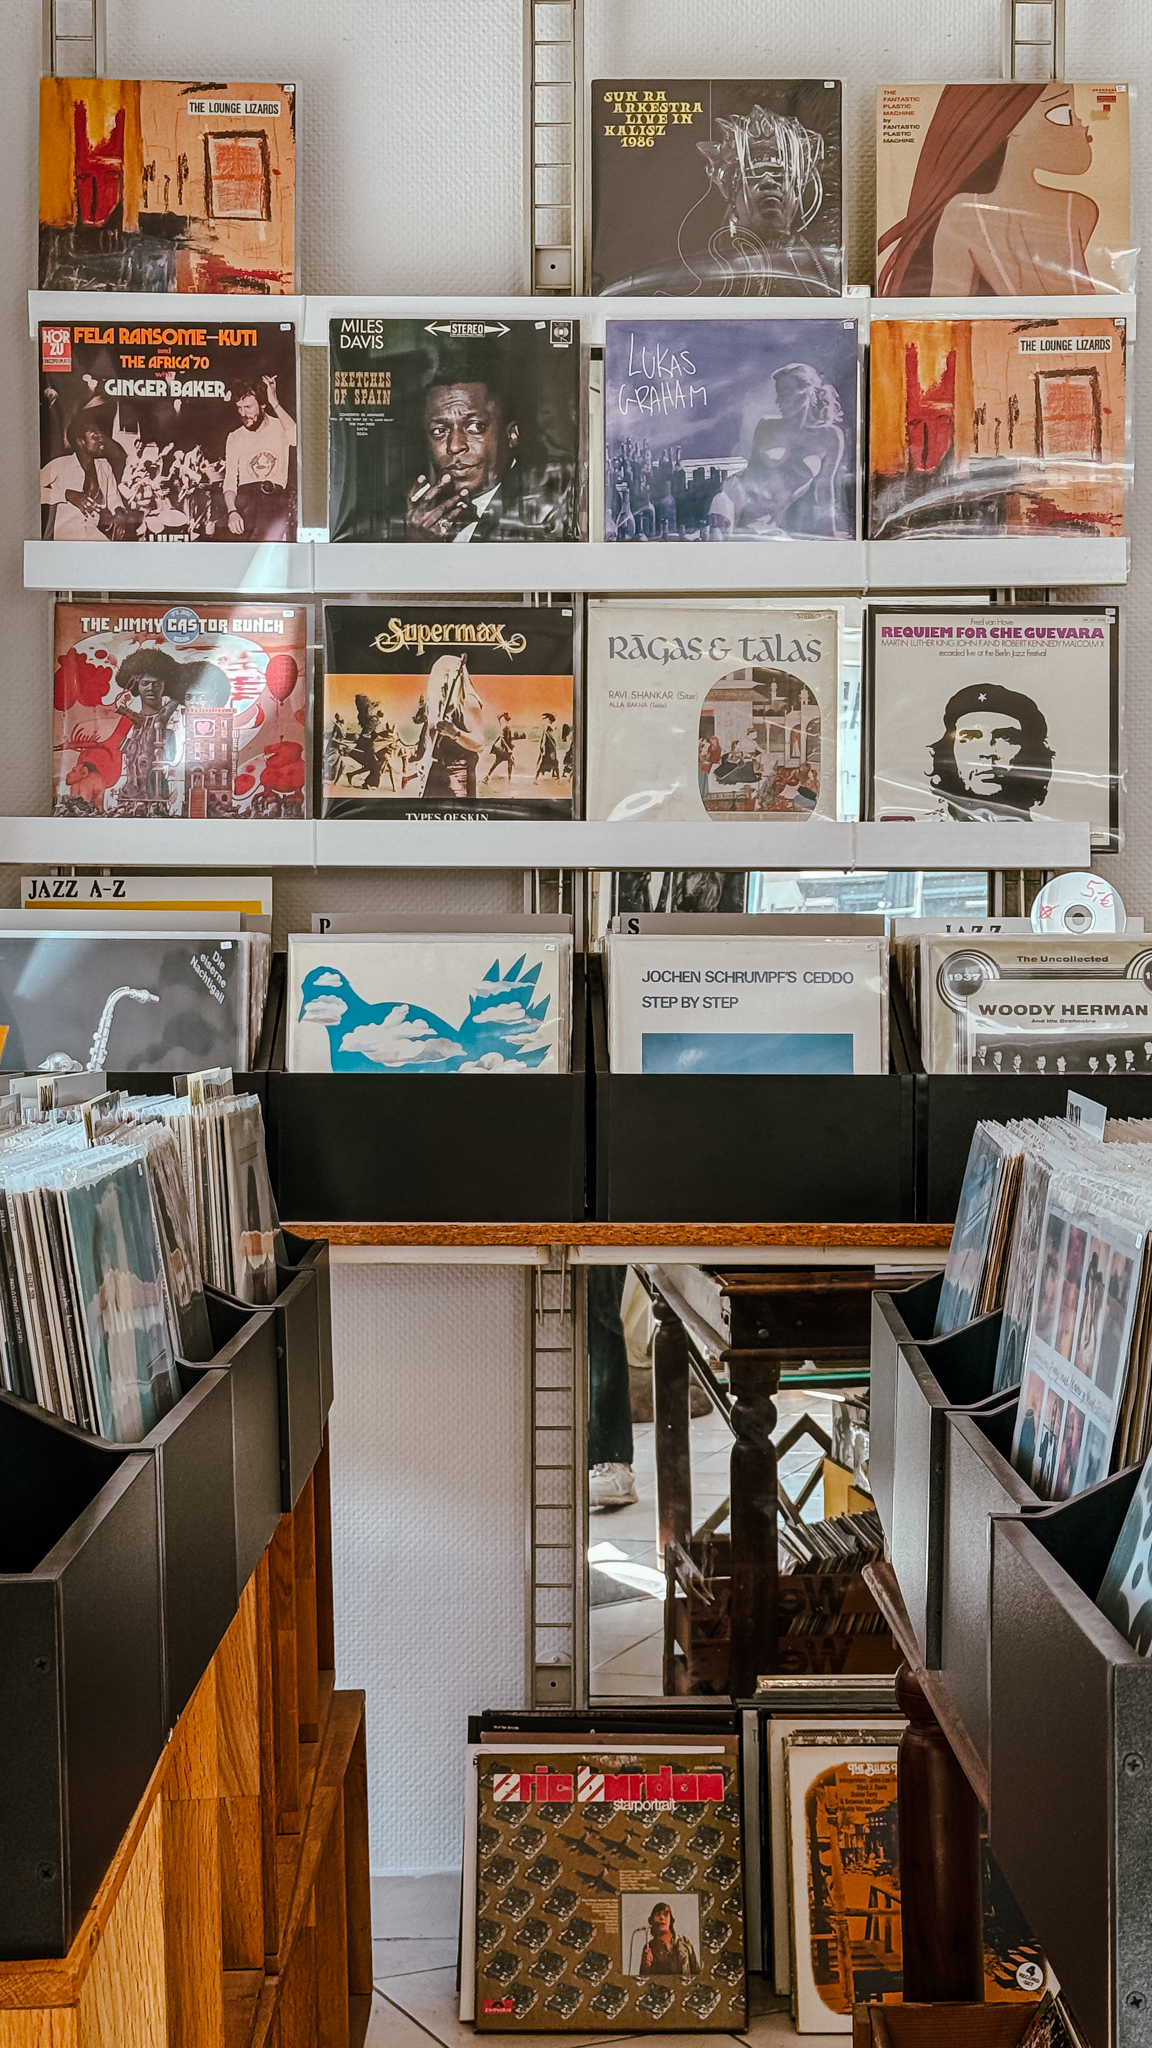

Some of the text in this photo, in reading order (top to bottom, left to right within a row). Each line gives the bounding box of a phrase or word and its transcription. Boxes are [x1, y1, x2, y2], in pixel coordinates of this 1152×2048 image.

[603, 91, 667, 103] SUN RA
[189, 102, 279, 114] THE LOUNGE LIZARDS
[612, 102, 703, 113] ARKESTRA
[625, 114, 693, 124] LIVE IN
[603, 125, 666, 136] KALISZ
[620, 137, 655, 148] 1986
[341, 319, 384, 334] MILES
[451, 323, 484, 335] STEREO
[74, 327, 114, 344] FELA
[340, 335, 384, 350] DAVIS
[50, 343, 65, 356] ZU
[1020, 339, 1111, 351] THE LOUNGE LIZARDS
[120, 355, 145, 369] THE
[628, 333, 697, 379] LUKAS
[334, 372, 391, 388] SKETCHES
[104, 380, 226, 397] GINGER BAKER
[334, 389, 391, 405] OF SPAIN
[619, 380, 707, 416] GRAHAM
[81, 617, 284, 634] THE JIMMY CASTOR BUNCH
[881, 626, 1105, 639] REQUIEM FOR CHE GUEVARA
[370, 617, 527, 656] Supermax
[936, 639, 955, 647] KING
[956, 639, 977, 647] JOHN
[709, 637, 732, 661] &
[608, 690, 627, 699] RAVI
[631, 690, 674, 699] SHANKAR
[28, 880, 126, 899] JAZZ A-Z
[319, 918, 331, 934] P
[627, 918, 640, 934] S
[212, 950, 226, 970] Die
[1017, 955, 1109, 963] The Uncollected
[200, 953, 227, 989] eiserne
[642, 970, 854, 984] JOCHEN SCHRUMPF'S CEDDO
[948, 973, 981, 982] 1937
[190, 955, 225, 1004] Nachtigall
[642, 996, 739, 1009] STEP BY STEP
[978, 1004, 1148, 1016] WOODY HERMAN
[847, 1763, 865, 1775] THE
[865, 1763, 890, 1776] BLUES
[613, 1798, 676, 1812] starportrait
[1026, 1965, 1036, 1977] 4
